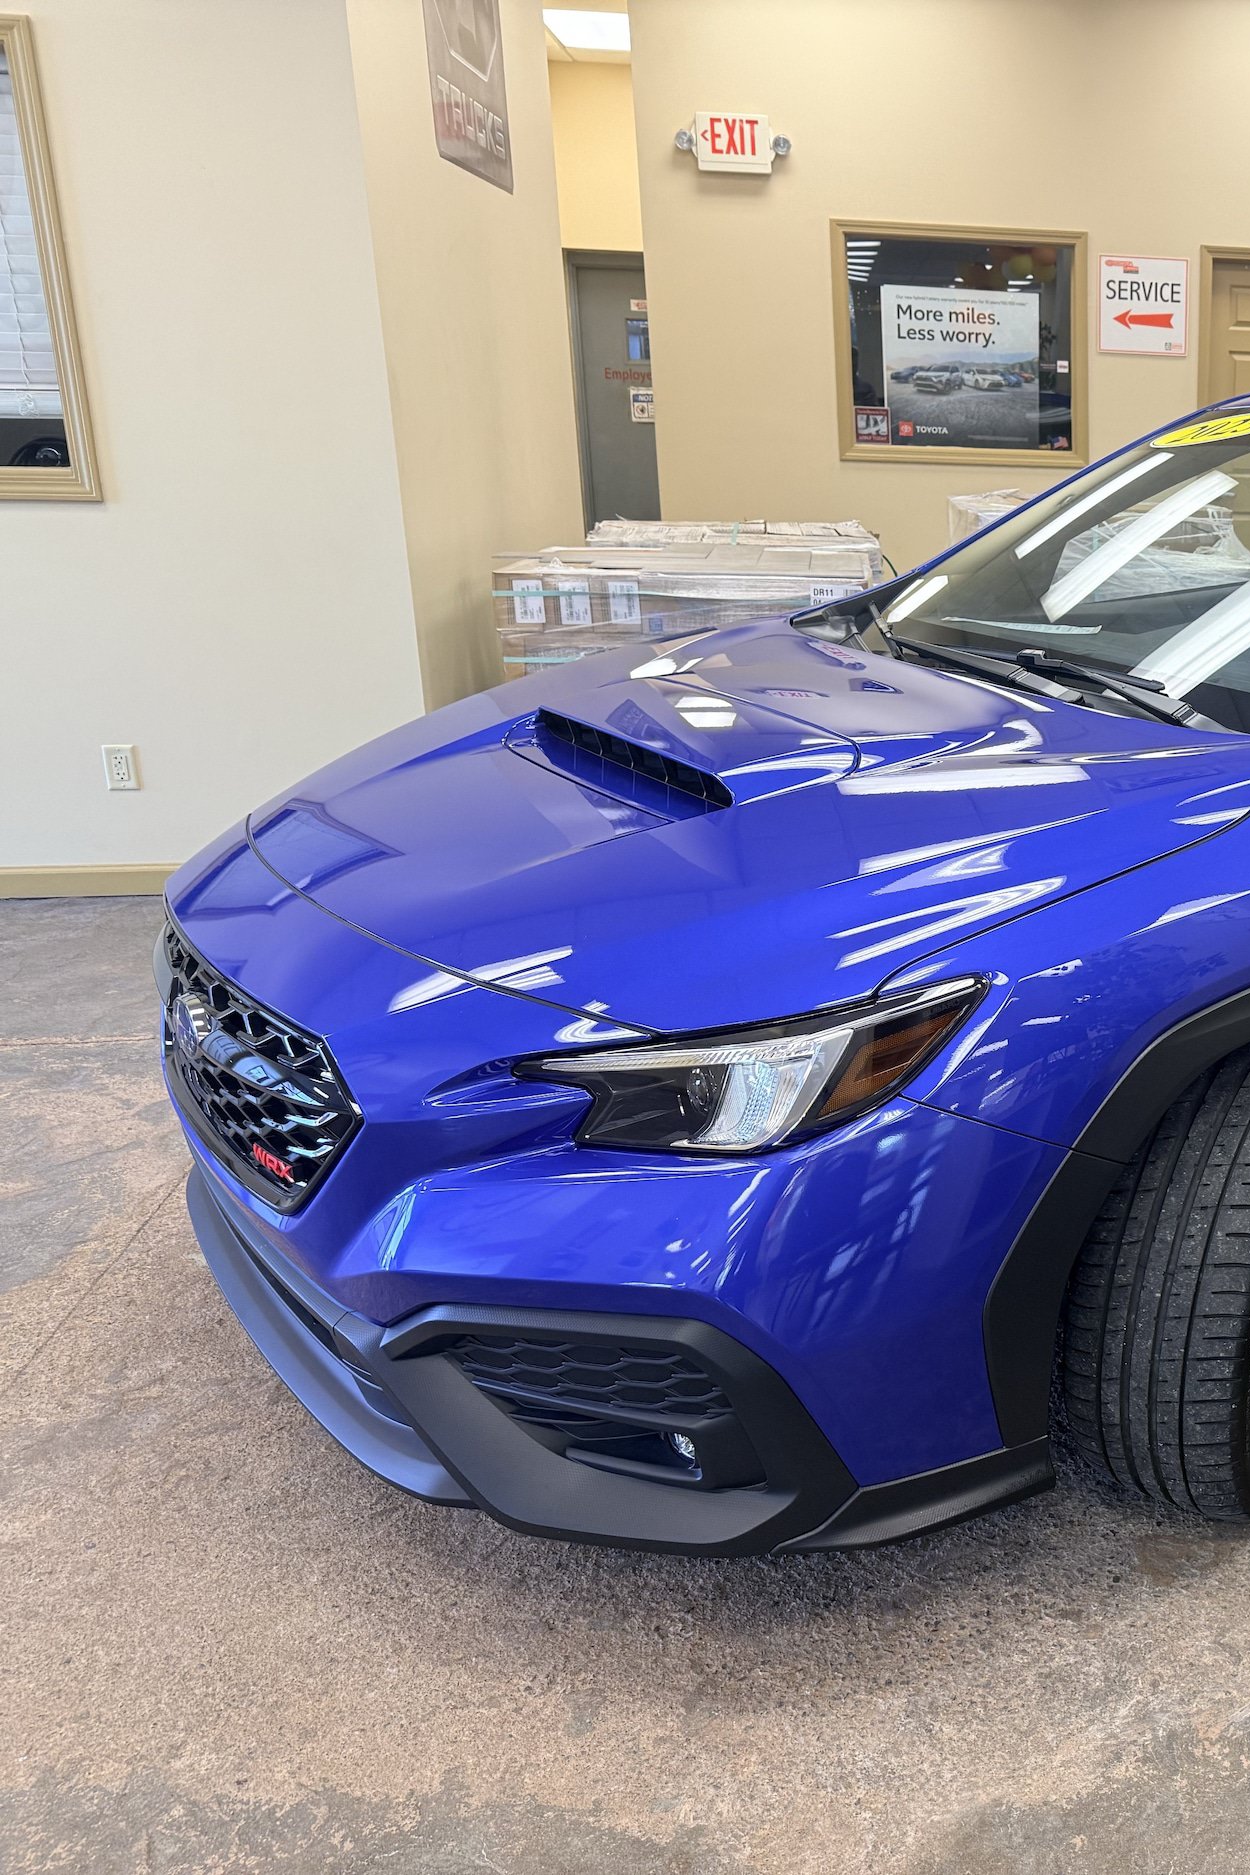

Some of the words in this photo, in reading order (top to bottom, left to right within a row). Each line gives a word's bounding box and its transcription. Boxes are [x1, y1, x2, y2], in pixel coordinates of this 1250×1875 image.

[437, 75, 506, 160] TRUCKS
[709, 118, 759, 156] EXIT
[1106, 280, 1181, 303] SERVICE
[897, 304, 943, 322] More
[949, 307, 1000, 325] miles.
[897, 323, 935, 341] Less
[940, 329, 996, 348] worry.
[915, 425, 949, 435] TOYOTA
[813, 588, 834, 597] DR11
[252, 1142, 295, 1183] WRX
